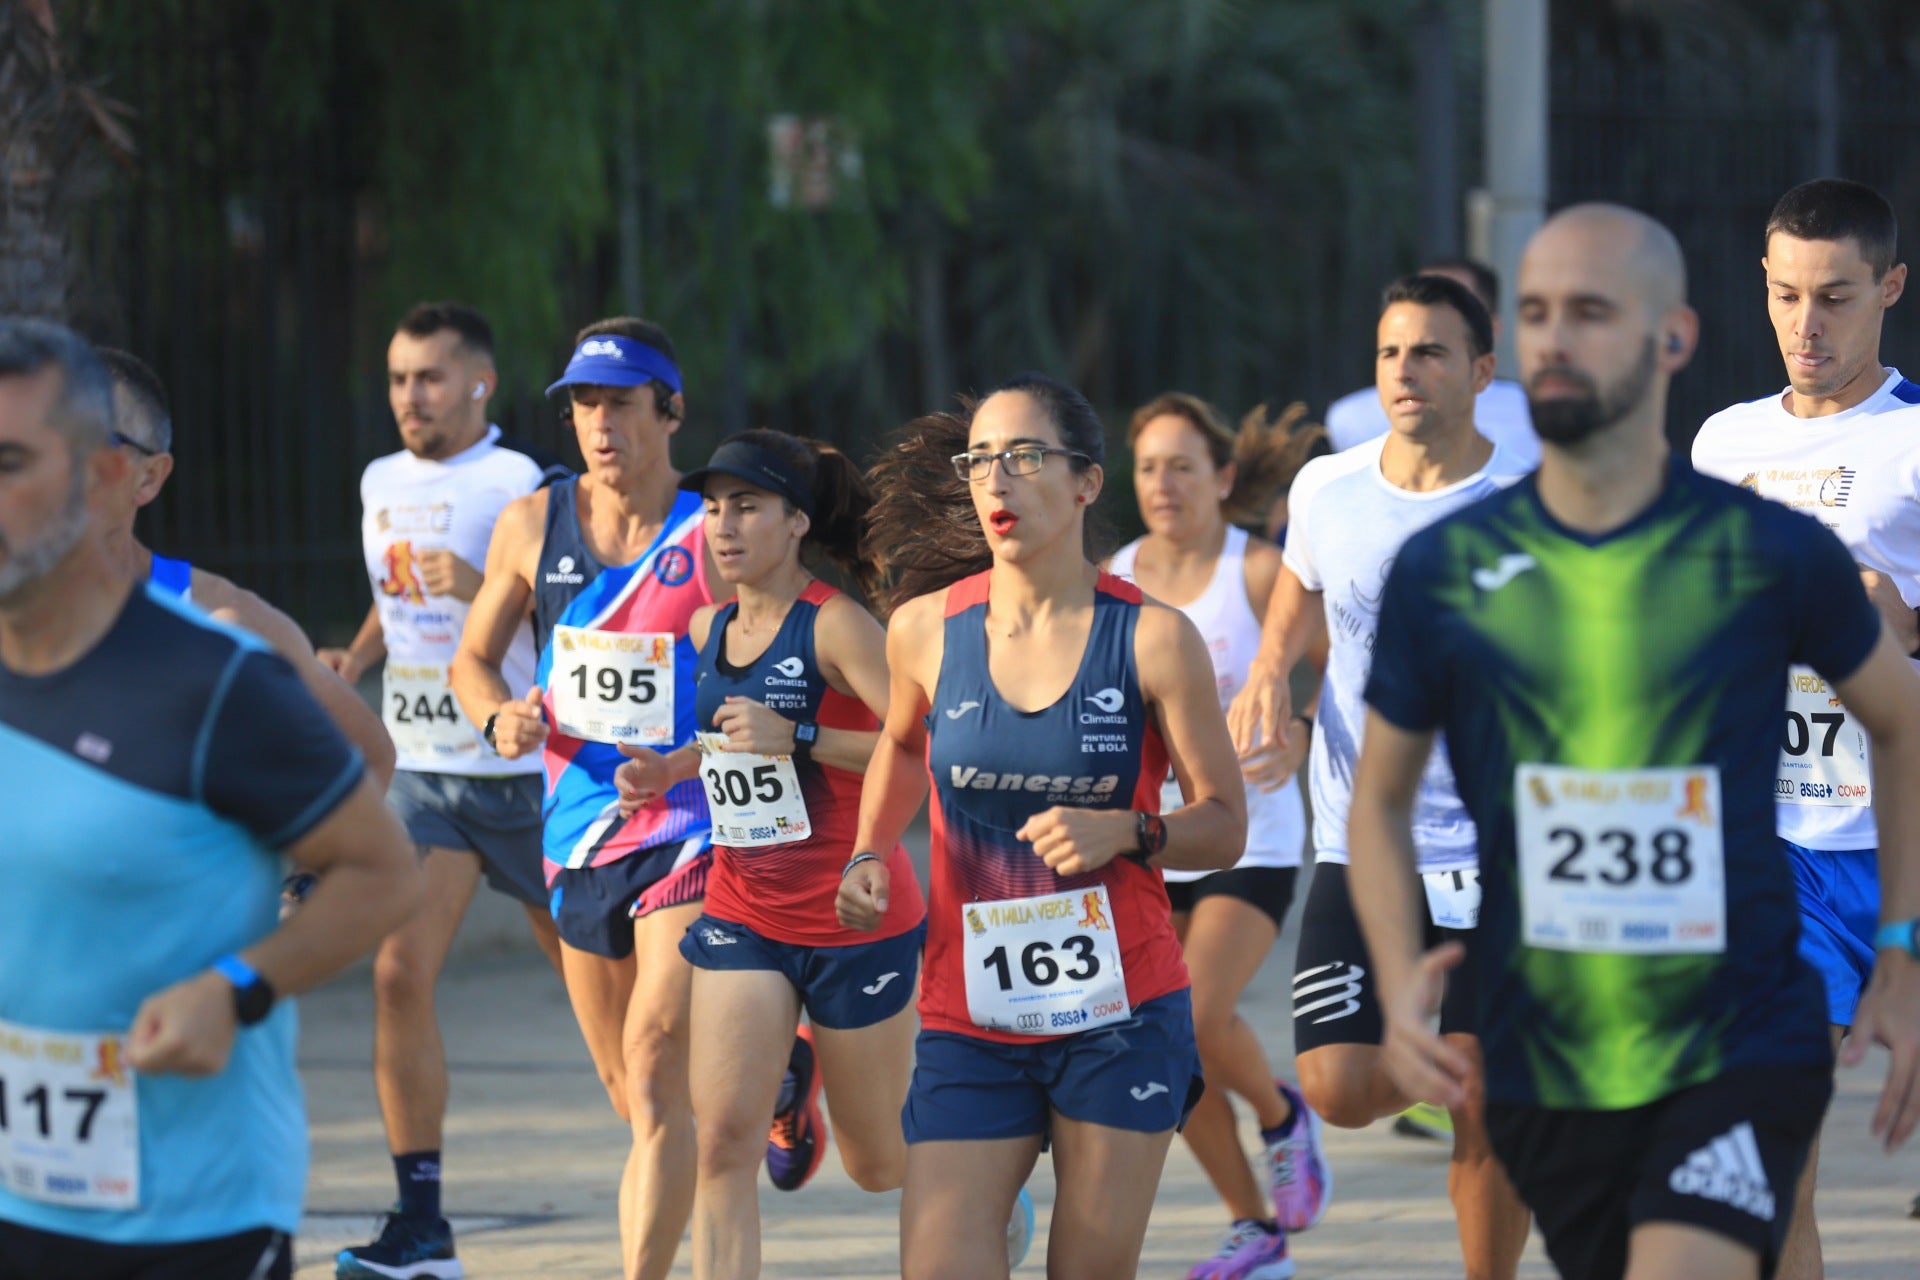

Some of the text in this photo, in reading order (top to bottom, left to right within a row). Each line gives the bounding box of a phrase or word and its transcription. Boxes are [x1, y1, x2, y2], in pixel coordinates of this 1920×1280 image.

[1780, 470, 1807, 480] MILLA
[570, 664, 657, 704] 195
[765, 676, 808, 687] Climatiza
[1792, 675, 1826, 693] VERDE
[766, 693, 806, 701] PINTURAS
[778, 701, 807, 709] BOLA
[393, 693, 458, 723] 244
[1079, 713, 1127, 725] Climatiza
[1082, 734, 1126, 742] PINTURAS
[1080, 743, 1128, 753] EL BOLA
[707, 765, 783, 807] 305
[950, 765, 1119, 794] Vanessa
[1800, 782, 1867, 798] asisa COVAP
[1045, 794, 1111, 804] CALZADOS
[1547, 827, 1693, 885] 238
[1002, 905, 1035, 926] MILLA
[1036, 898, 1075, 920] VERDE
[983, 935, 1101, 992] 163
[1051, 1001, 1124, 1028] asisa COVAP
